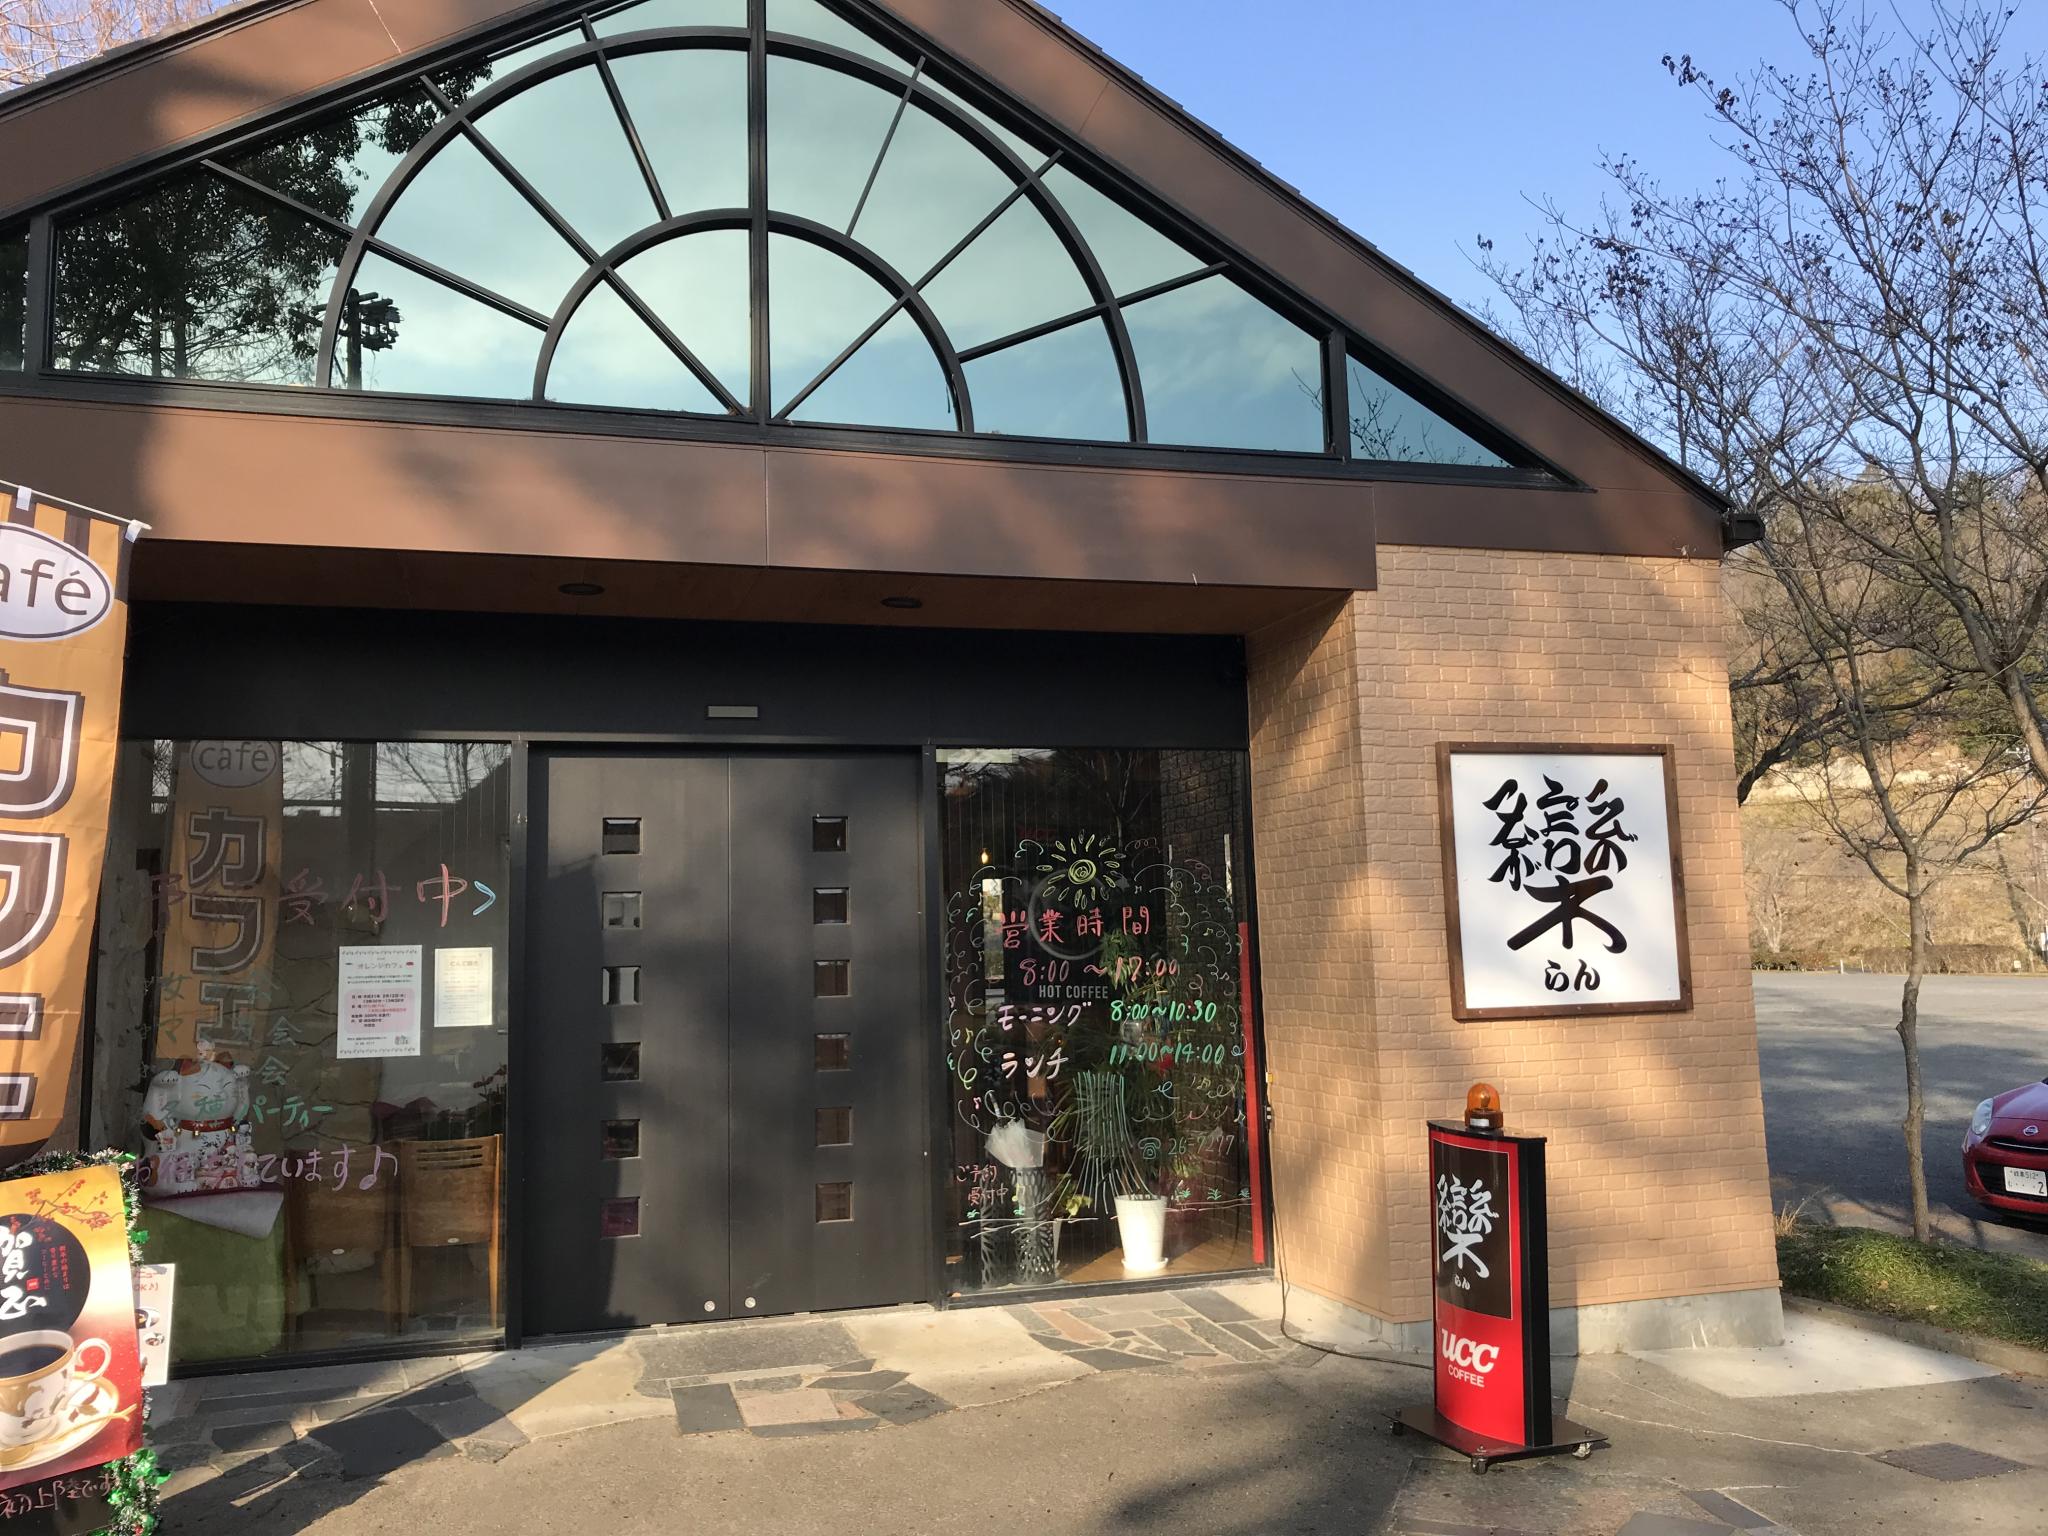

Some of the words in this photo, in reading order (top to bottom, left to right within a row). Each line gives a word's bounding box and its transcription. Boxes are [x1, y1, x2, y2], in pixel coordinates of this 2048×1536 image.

[0, 559, 92, 616] fé
[998, 905, 1150, 949] 営業時間
[1545, 959, 1600, 992] らん
[1039, 985, 1061, 999] HOT
[1066, 985, 1108, 999] COFFEE
[998, 1002, 1092, 1031] モーニング
[1001, 1046, 1069, 1079] ランチ
[956, 1164, 998, 1183] ご予約
[967, 1185, 1009, 1206] 受付中
[1441, 1328, 1499, 1374] UCC
[1448, 1364, 1485, 1388] COFFEE
